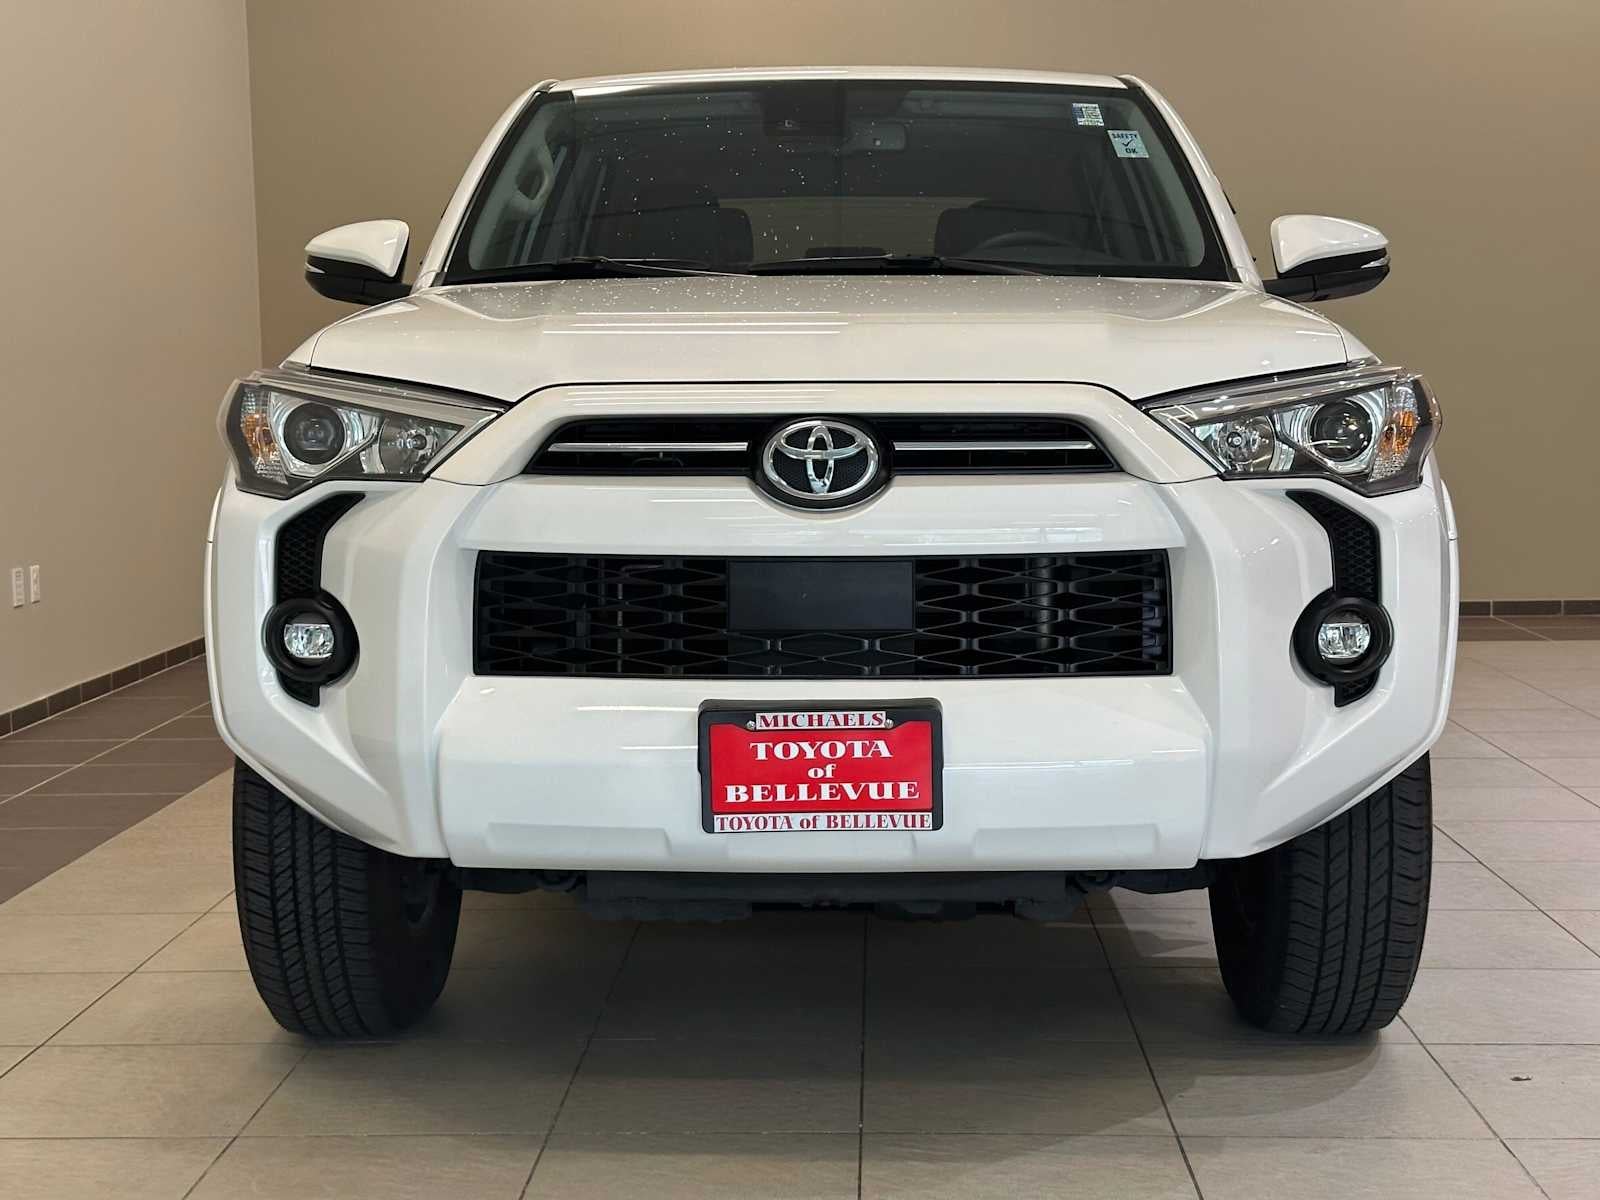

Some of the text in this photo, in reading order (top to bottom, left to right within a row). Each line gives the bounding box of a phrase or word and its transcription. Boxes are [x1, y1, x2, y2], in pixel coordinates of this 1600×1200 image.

[758, 712, 884, 729] MICHAELS
[749, 739, 893, 761] TOYOTA
[807, 763, 837, 779] of
[724, 781, 920, 803] BELLEVUE
[715, 813, 932, 832] TOYOTA of BELLEVUE
